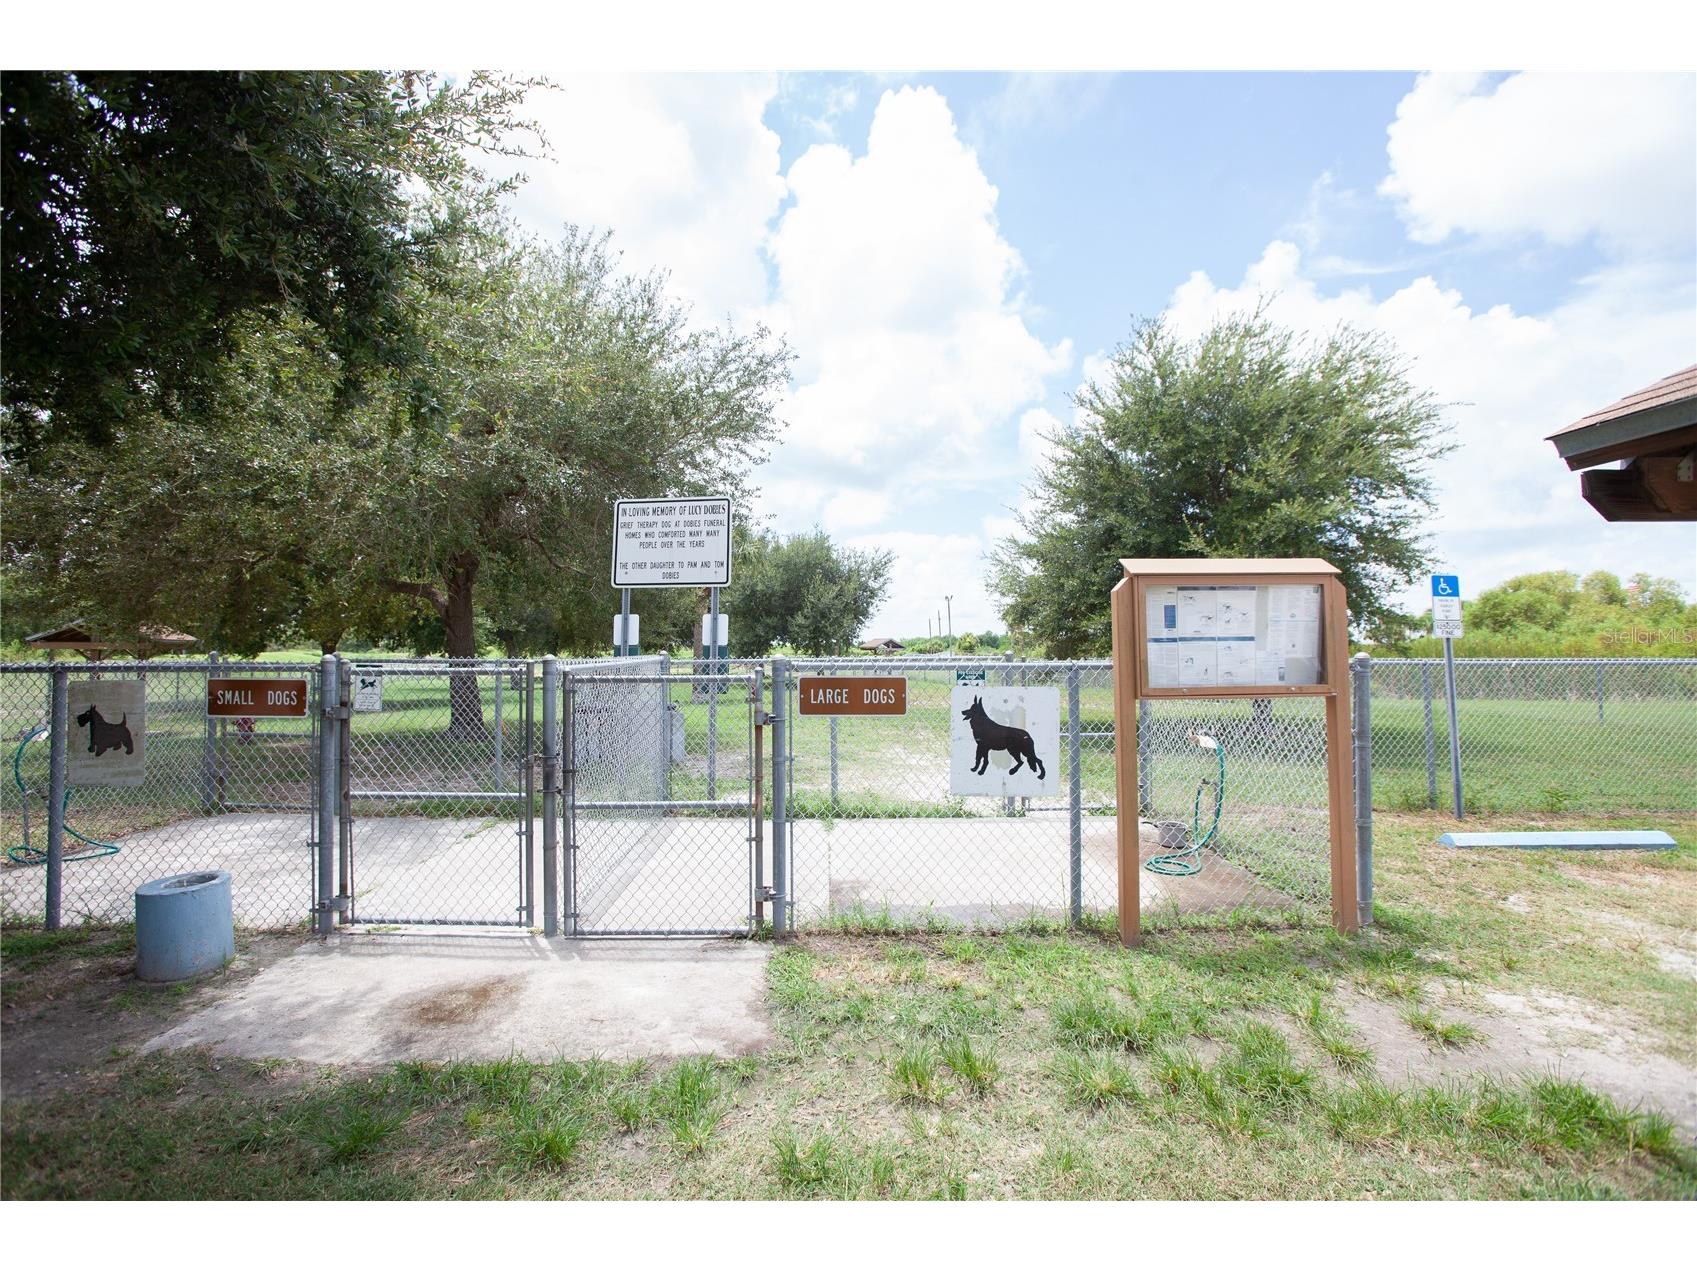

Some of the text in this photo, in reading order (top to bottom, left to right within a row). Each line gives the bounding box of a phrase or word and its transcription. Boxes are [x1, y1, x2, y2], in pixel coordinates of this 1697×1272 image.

[621, 504, 726, 516] IN LOVING MEMORY OF LUCY DOBIES
[217, 690, 297, 706] SMALL DOGS
[810, 689, 895, 704] LARGE DOGS
